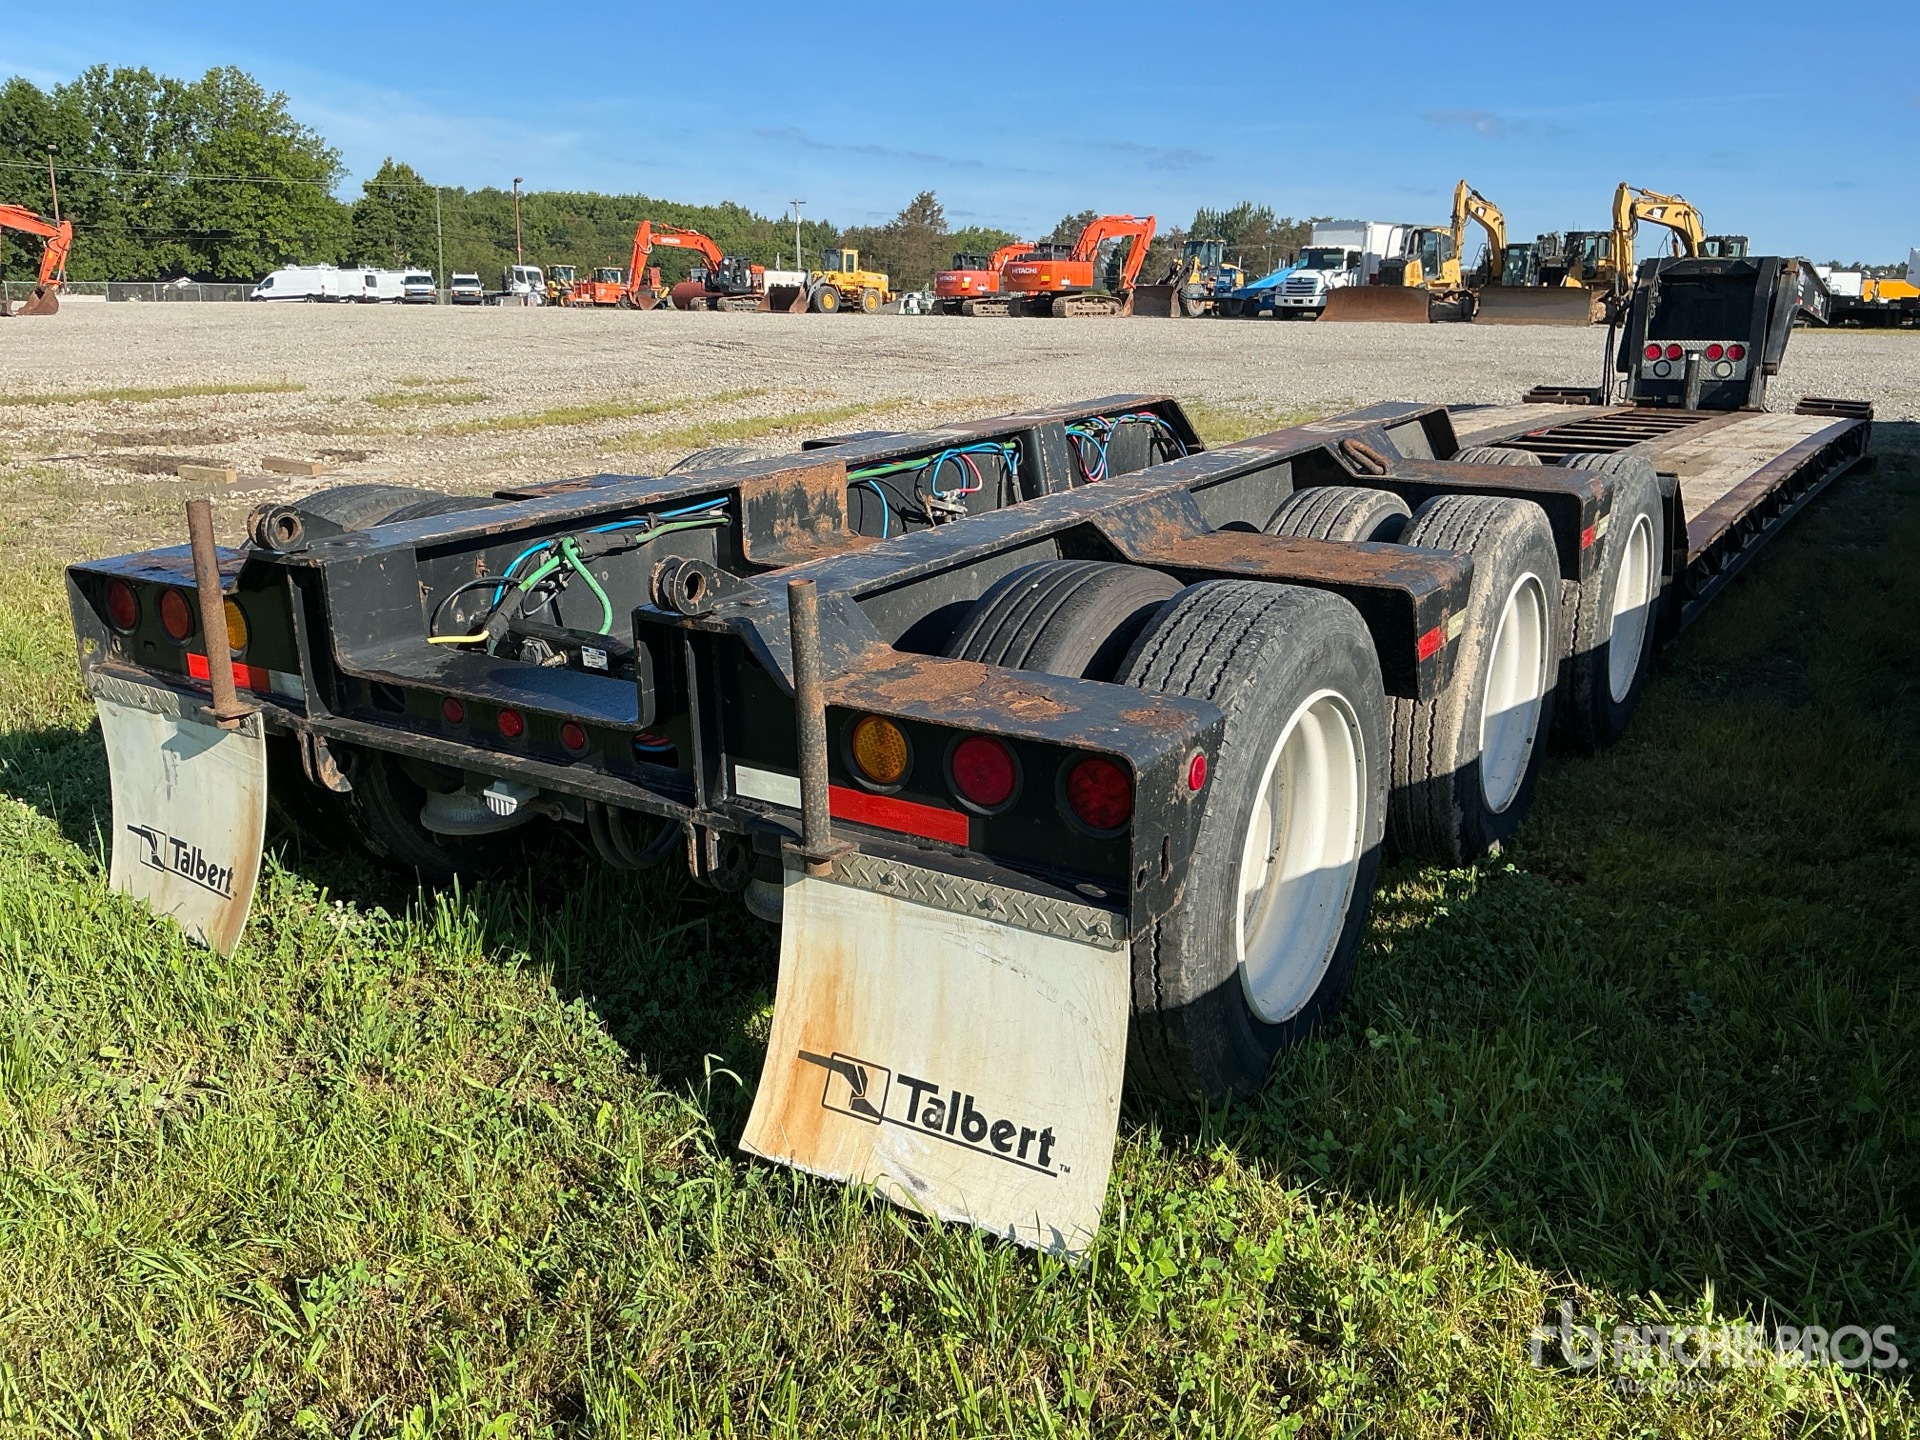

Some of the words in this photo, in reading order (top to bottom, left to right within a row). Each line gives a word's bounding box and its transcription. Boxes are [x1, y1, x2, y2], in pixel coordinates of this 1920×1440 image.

[1011, 267, 1038, 275] HITACHI
[169, 837, 234, 894] Talbert
[897, 1073, 1056, 1167] Talbert
